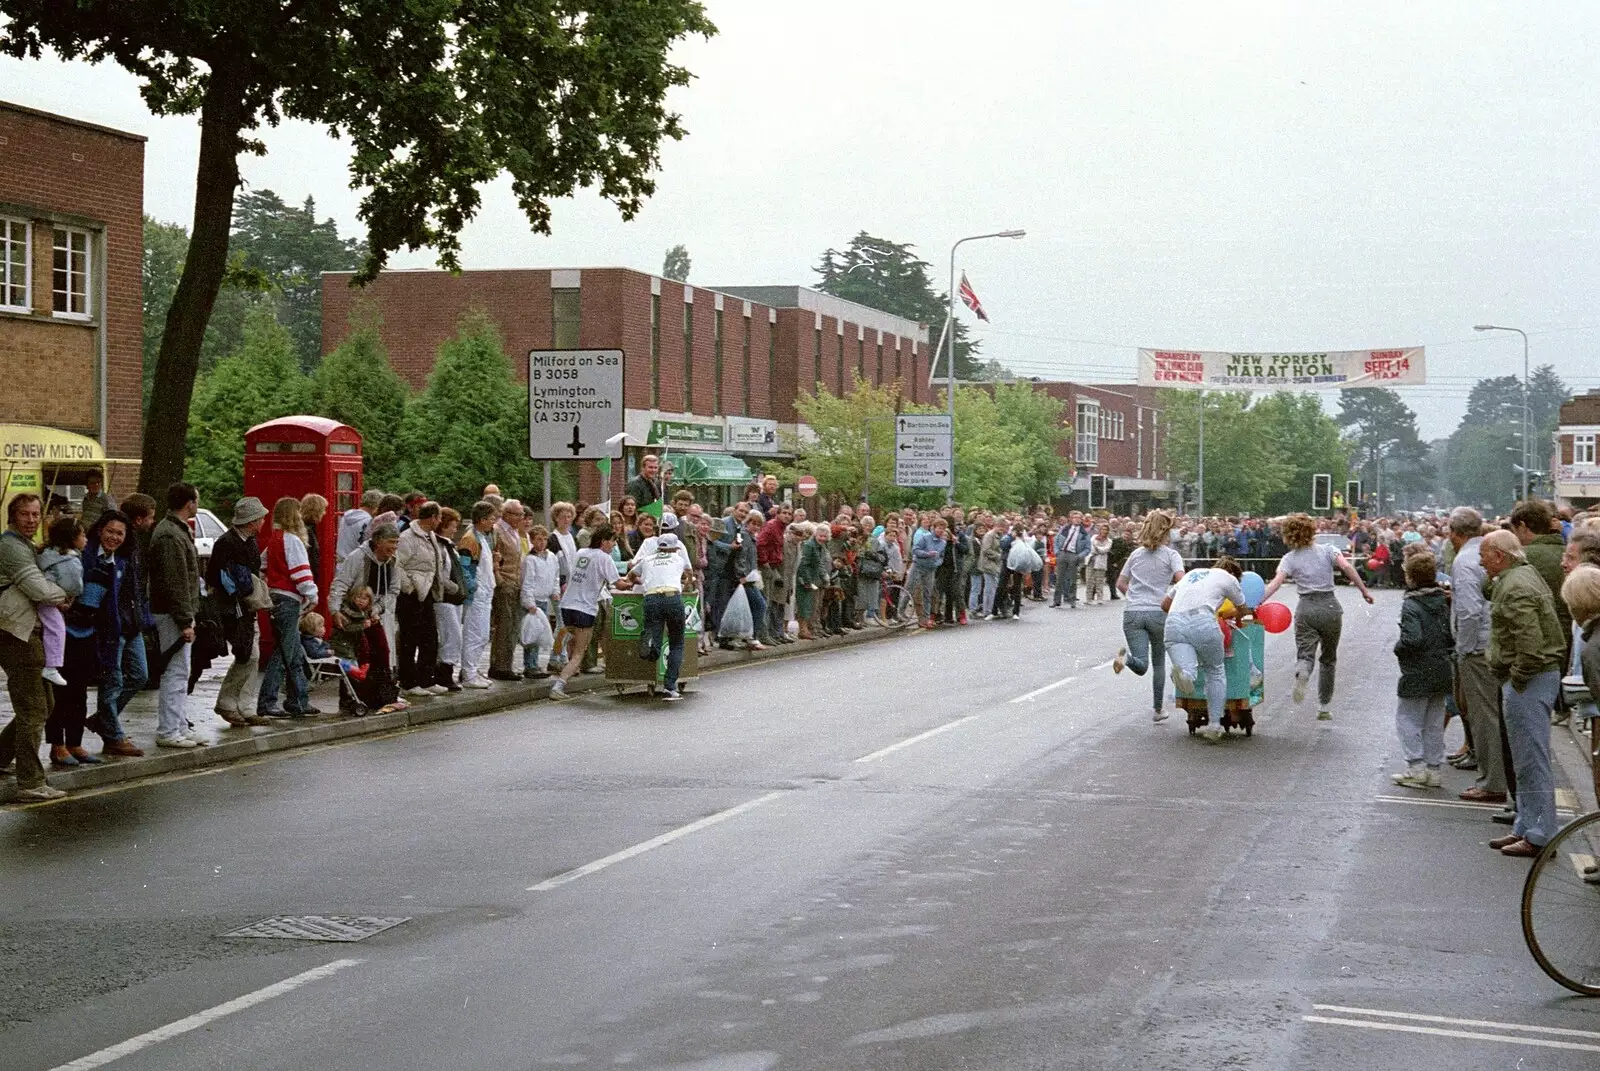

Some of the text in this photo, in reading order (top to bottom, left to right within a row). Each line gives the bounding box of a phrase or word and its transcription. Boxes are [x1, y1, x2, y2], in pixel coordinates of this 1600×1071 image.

[534, 355, 618, 366] Milford on Sea
[1231, 354, 1327, 365] NEW FOREST
[1371, 351, 1403, 359] SUNDAY
[1226, 363, 1333, 377] MARATHON
[1364, 358, 1409, 373] SEPT 14
[534, 369, 579, 379] B 3058
[534, 386, 596, 398] Lymington
[534, 399, 611, 409] Christchurch
[534, 411, 581, 423] (A 337)
[4, 444, 93, 459] OF NEW MILTON
